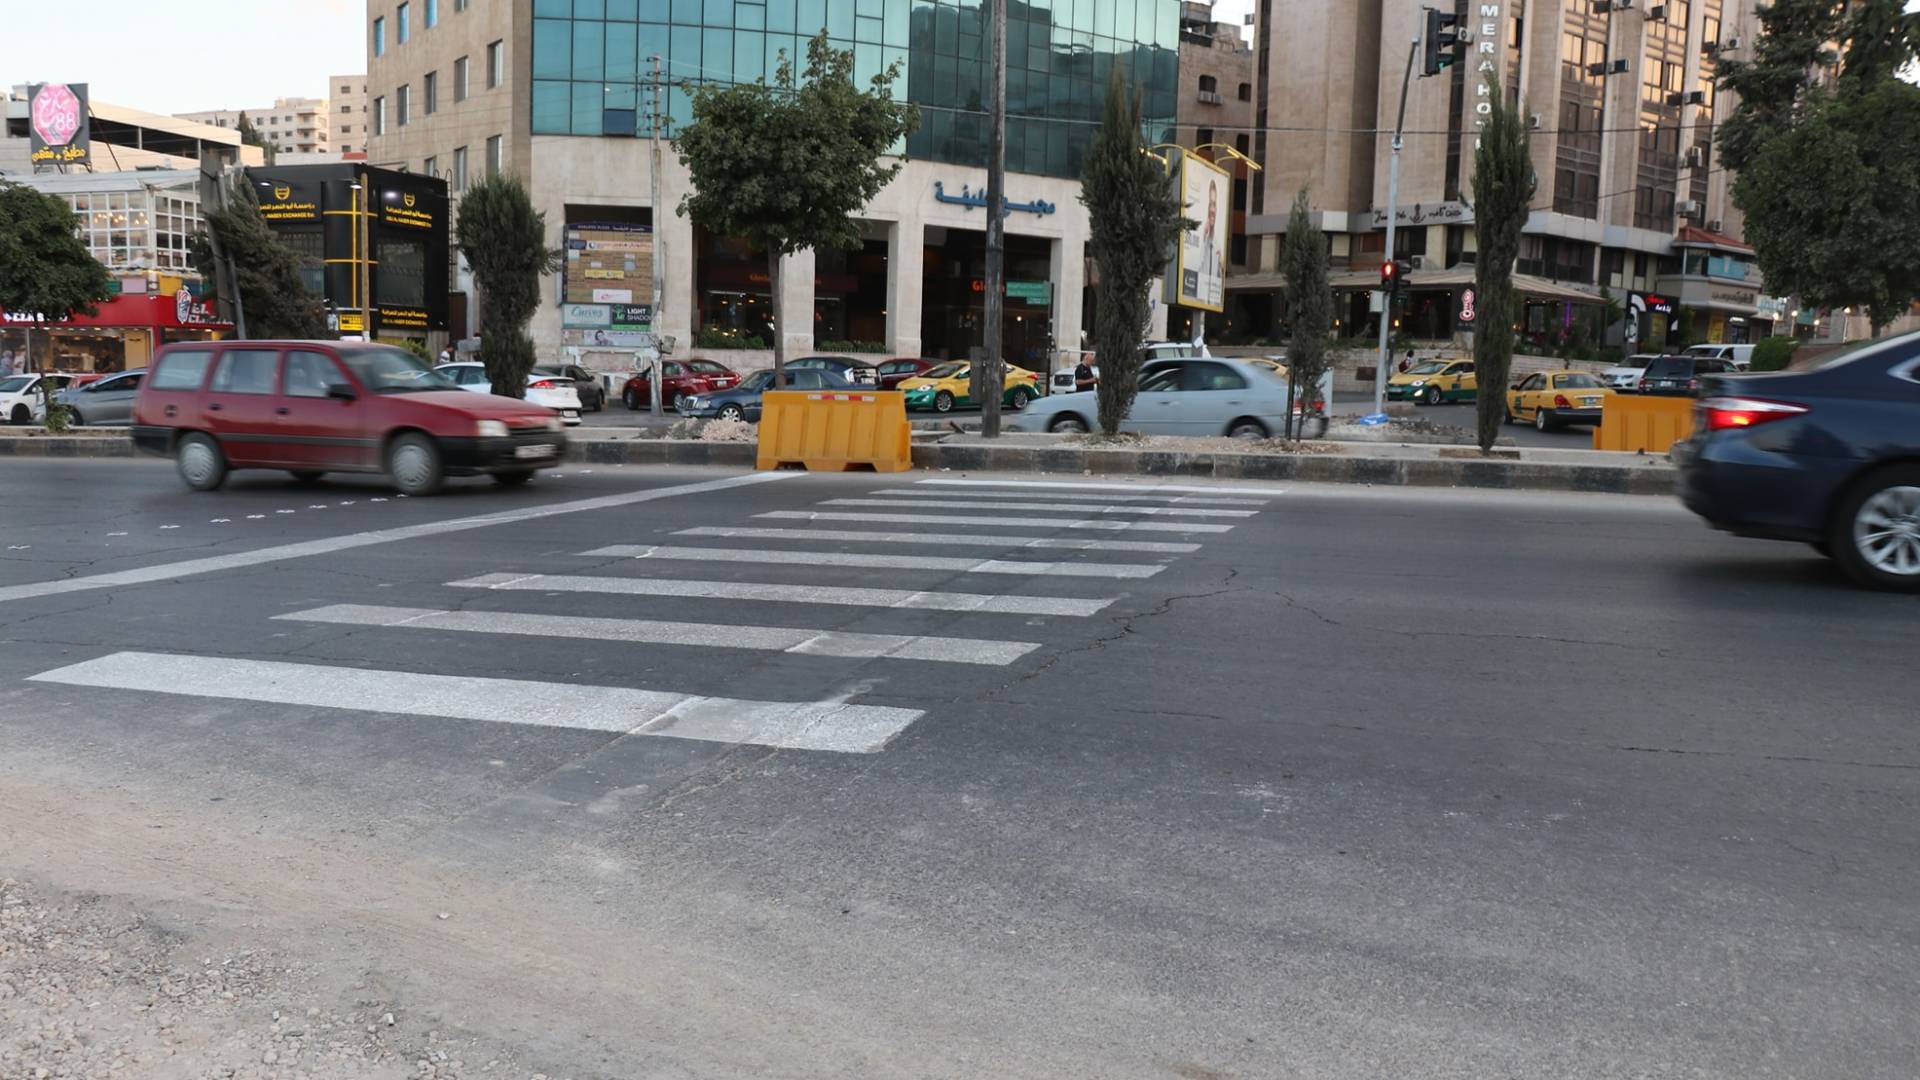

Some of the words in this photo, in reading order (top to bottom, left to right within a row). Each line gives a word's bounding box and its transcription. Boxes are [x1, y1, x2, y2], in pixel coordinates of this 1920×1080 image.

[1478, 5, 1498, 71] MERA
[56, 111, 76, 130] 88
[934, 180, 988, 211] ليفة
